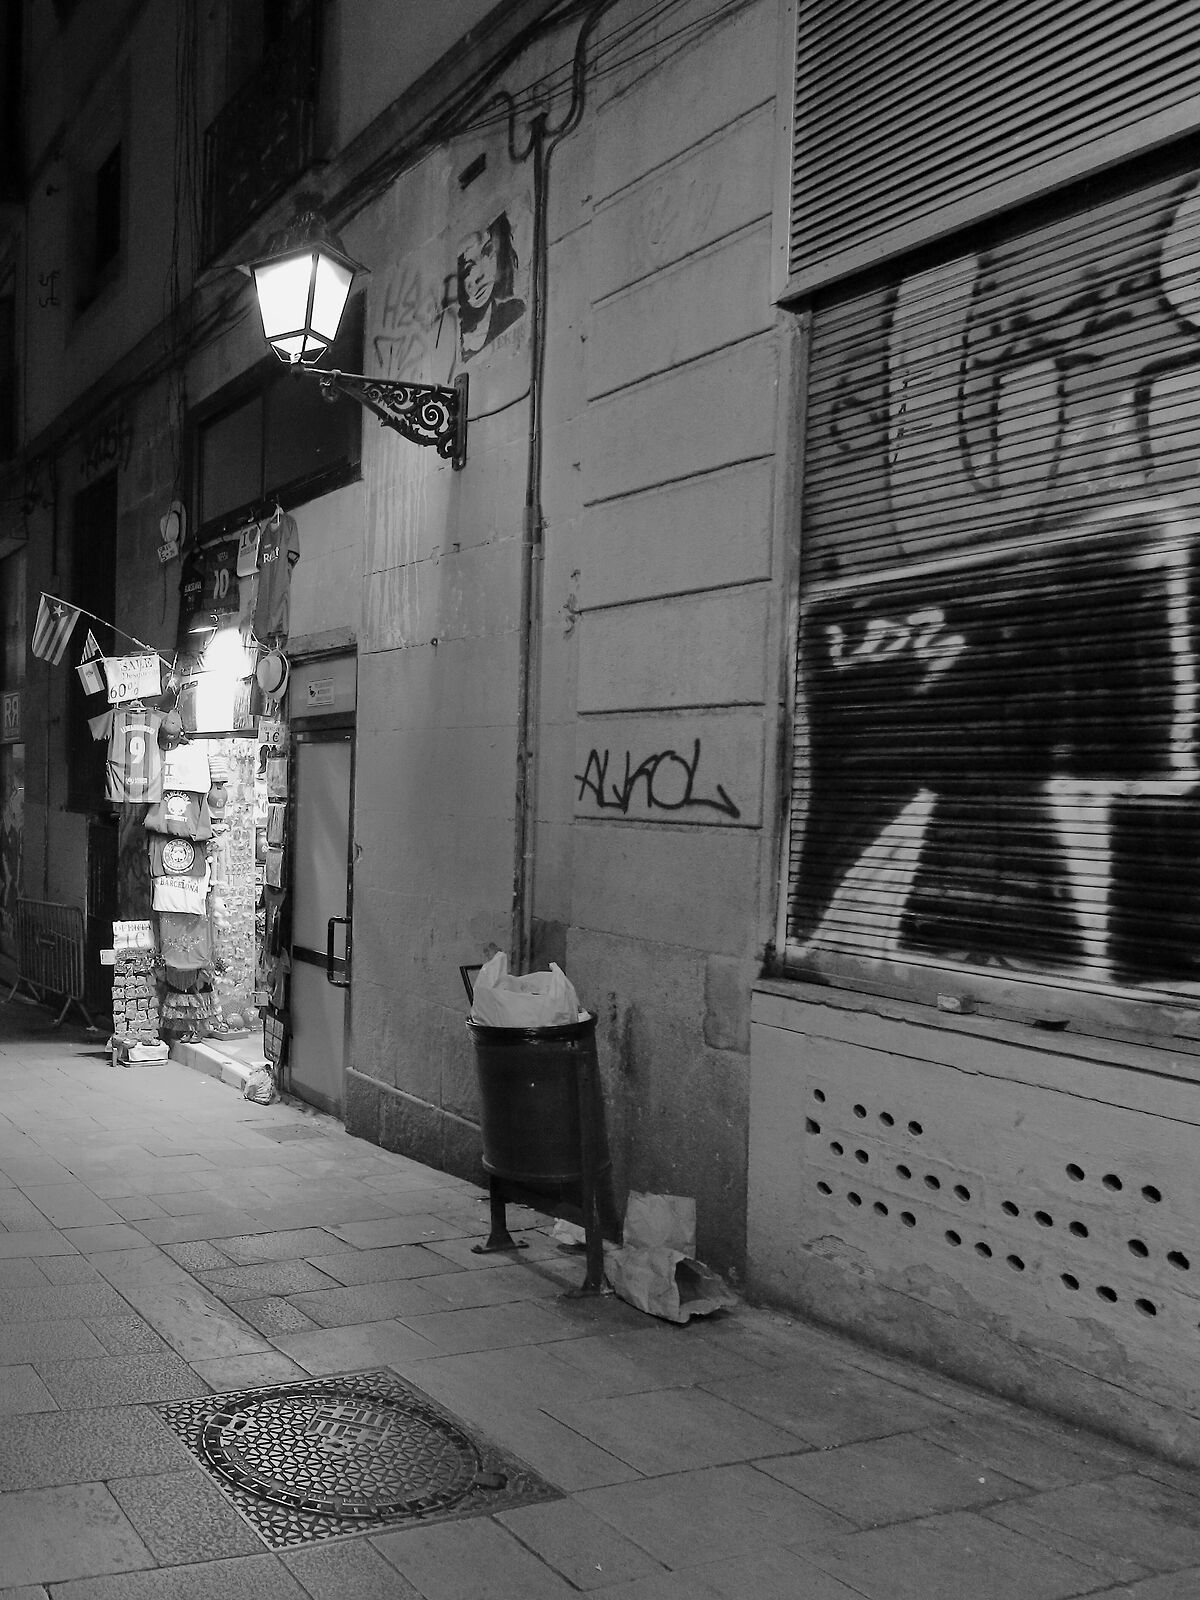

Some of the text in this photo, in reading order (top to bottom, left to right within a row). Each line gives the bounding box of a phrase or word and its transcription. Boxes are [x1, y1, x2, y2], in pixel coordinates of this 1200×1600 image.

[213, 568, 230, 600] 10
[129, 736, 146, 764] 9
[159, 878, 199, 894] BARCELONA
